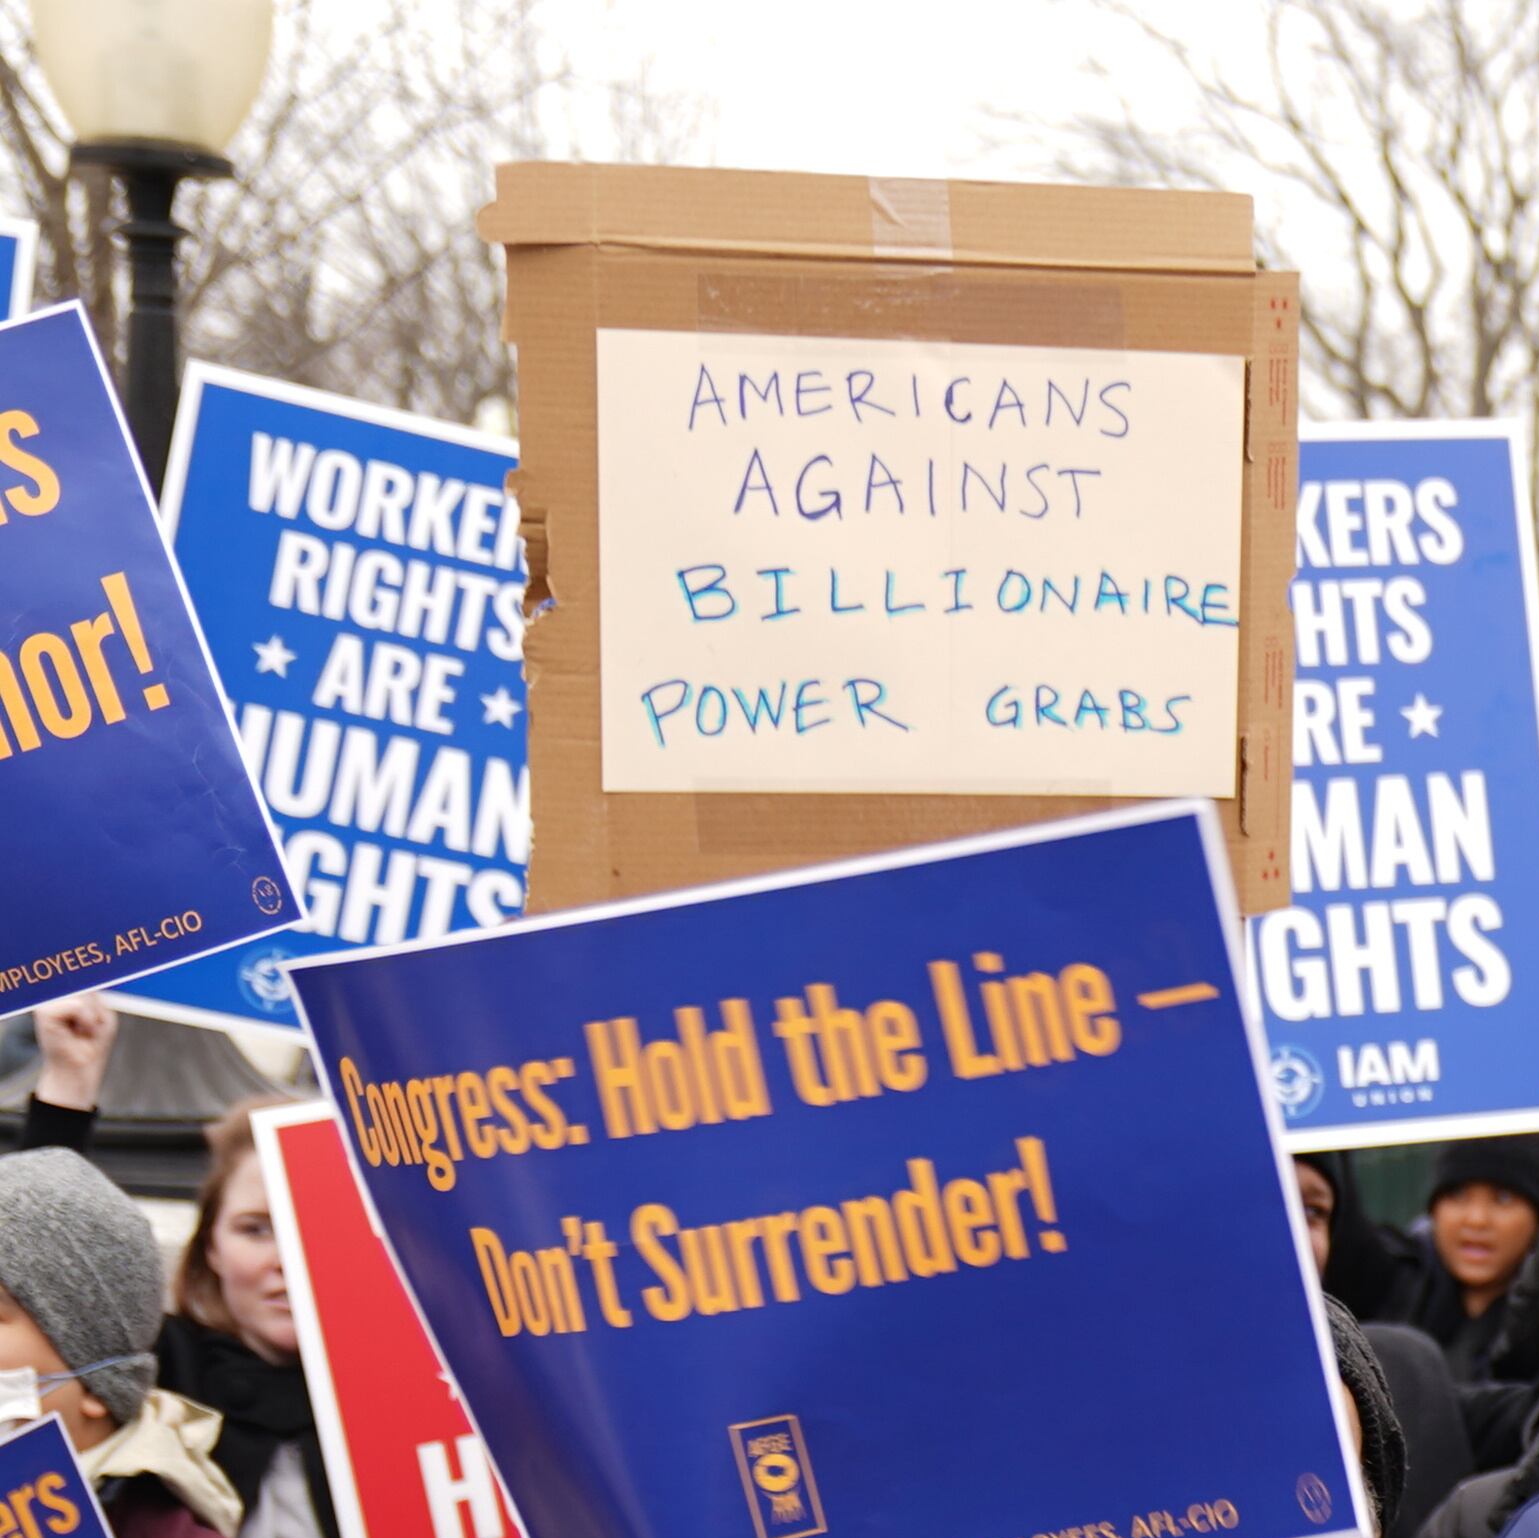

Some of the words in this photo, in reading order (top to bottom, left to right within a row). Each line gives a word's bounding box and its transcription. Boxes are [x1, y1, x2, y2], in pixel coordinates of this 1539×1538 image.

[688, 364, 1134, 438] AMERICANS
[248, 431, 528, 572] WORKE
[734, 447, 1102, 521] AGAINST
[1295, 477, 1464, 568] KERS
[269, 528, 526, 661] RIGHTS
[676, 564, 1239, 627] BILLIONAIRE
[1292, 576, 1433, 668] HTS
[0, 571, 170, 760] nor!
[312, 632, 464, 736] ARE
[641, 678, 916, 747] POWER
[985, 684, 1193, 736] GRABS
[1292, 677, 1382, 765] RE
[1291, 770, 1495, 892] MAN
[276, 826, 527, 947] GHTS
[0, 942, 111, 993] MPLOYEES,
[115, 910, 202, 955] AFL-CIO
[1250, 893, 1512, 1022] GHTS
[340, 1056, 590, 1192] Congress:
[584, 996, 771, 1140] Hold
[773, 983, 928, 1105] the
[928, 950, 1122, 1082] Line
[1337, 1038, 1440, 1088] IAM
[470, 1214, 632, 1340] Don't
[629, 1135, 1067, 1325] Surrender!
